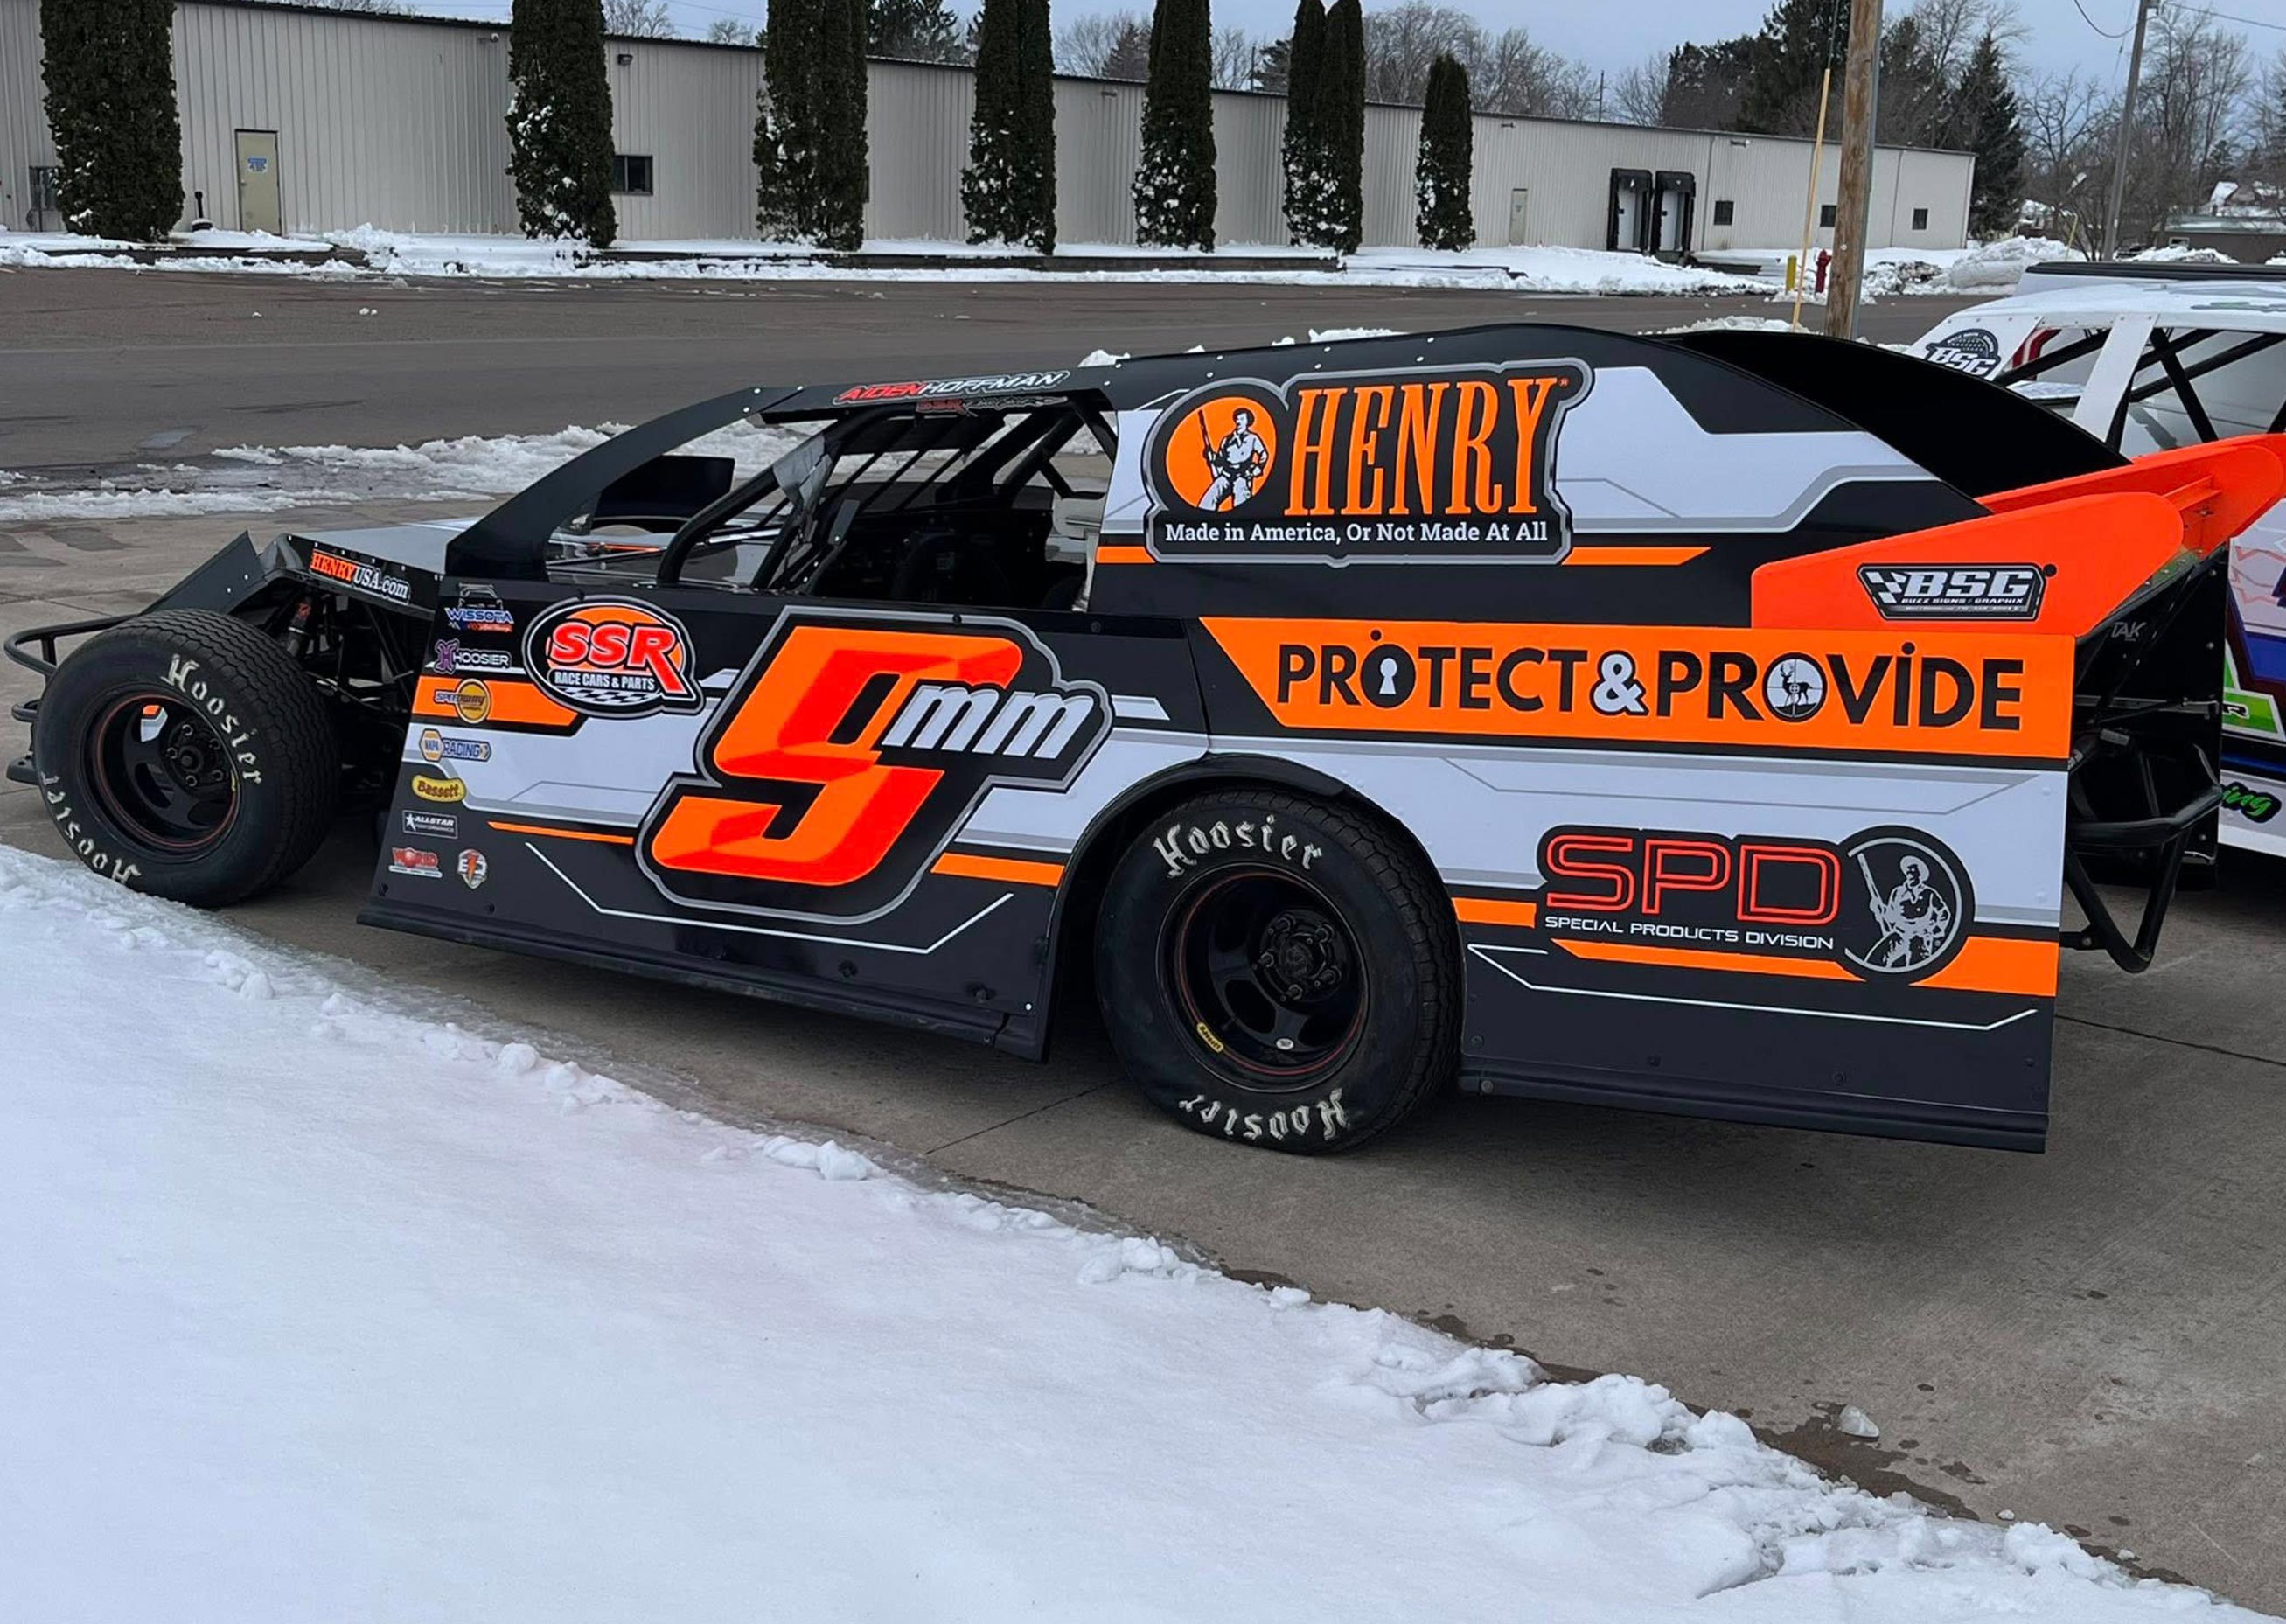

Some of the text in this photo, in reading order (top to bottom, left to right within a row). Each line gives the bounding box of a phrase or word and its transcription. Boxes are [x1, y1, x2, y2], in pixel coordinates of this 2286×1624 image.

[1927, 347, 1996, 375] BSG
[1165, 521, 1547, 545] Made in America, Or Not Made At All
[1902, 571, 2034, 597] BSG
[443, 607, 514, 624] WISSOTA
[453, 652, 510, 666] HOOSIER
[550, 622, 687, 694] SSR
[554, 672, 655, 690] RACE CARS & PARTS
[160, 653, 263, 785] Hoosier
[416, 780, 461, 798] Bassett
[41, 771, 142, 884] Hoosier
[415, 815, 455, 826] ALLSTAR
[1153, 814, 1322, 878] Hoosier
[1546, 833, 1841, 924] SPD
[1544, 917, 1834, 949] SPECIAL PRODUCTS DIVISION
[1177, 1088, 1350, 1140] Hoosier
